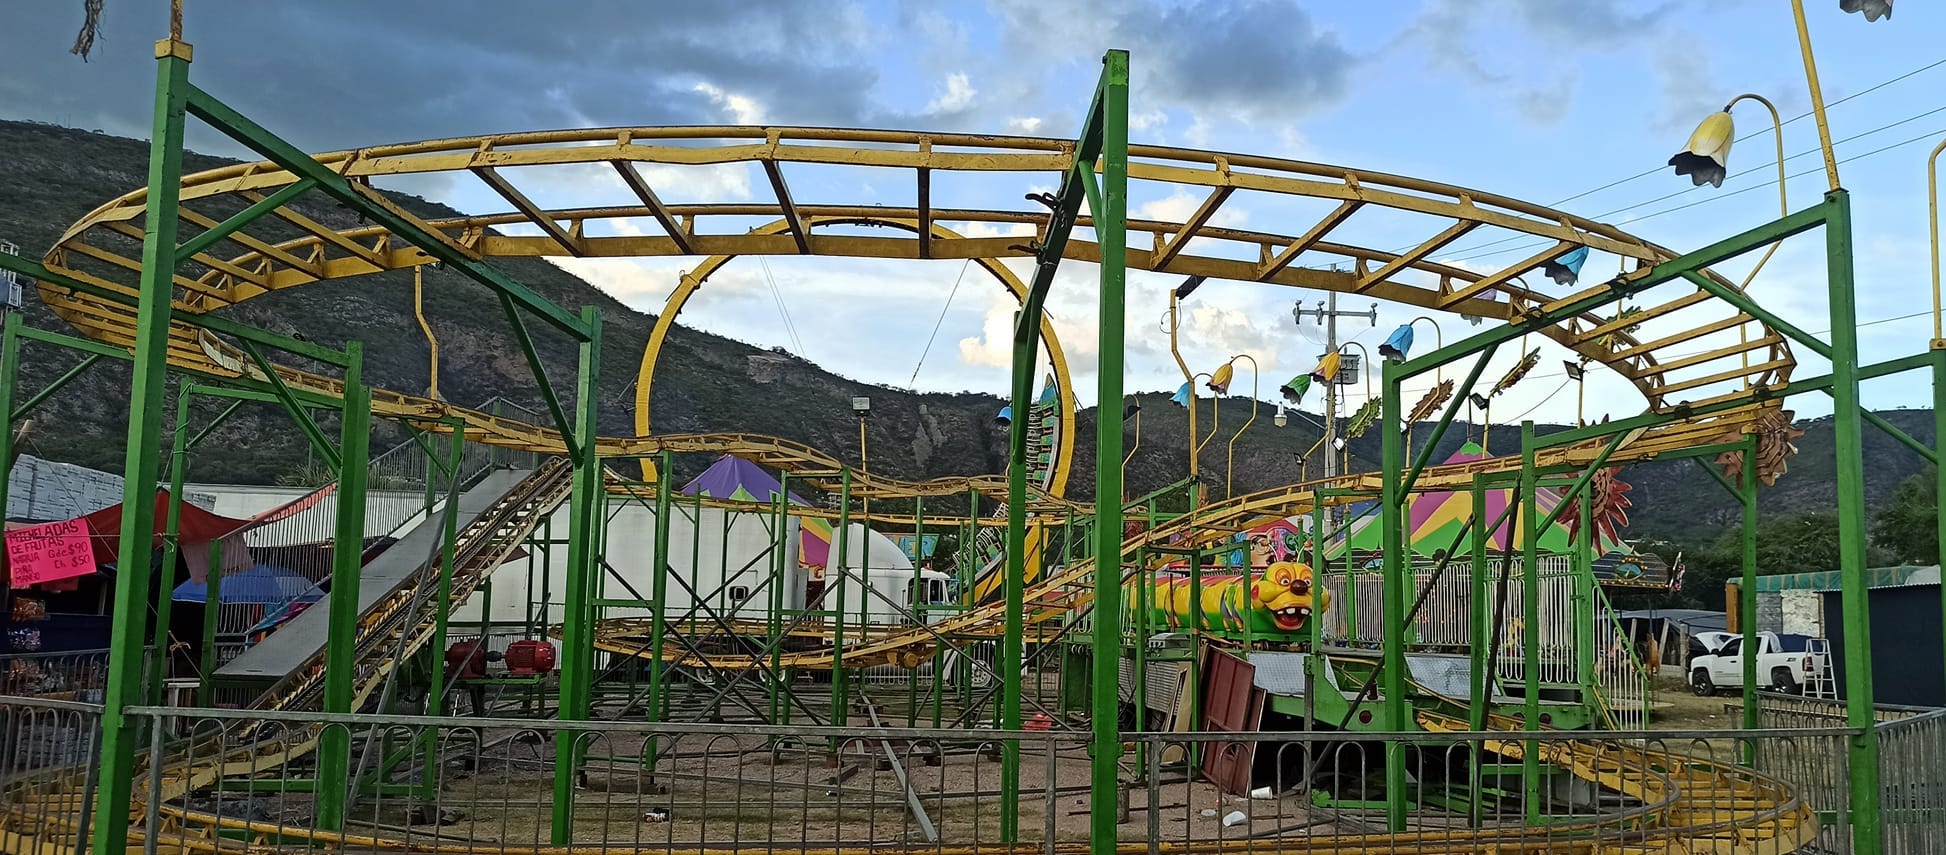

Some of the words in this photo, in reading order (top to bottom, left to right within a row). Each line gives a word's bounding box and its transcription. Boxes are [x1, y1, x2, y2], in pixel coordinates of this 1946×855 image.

[11, 545, 23, 554] DE
[25, 537, 64, 551] FRUTAS
[71, 554, 90, 568] $50
